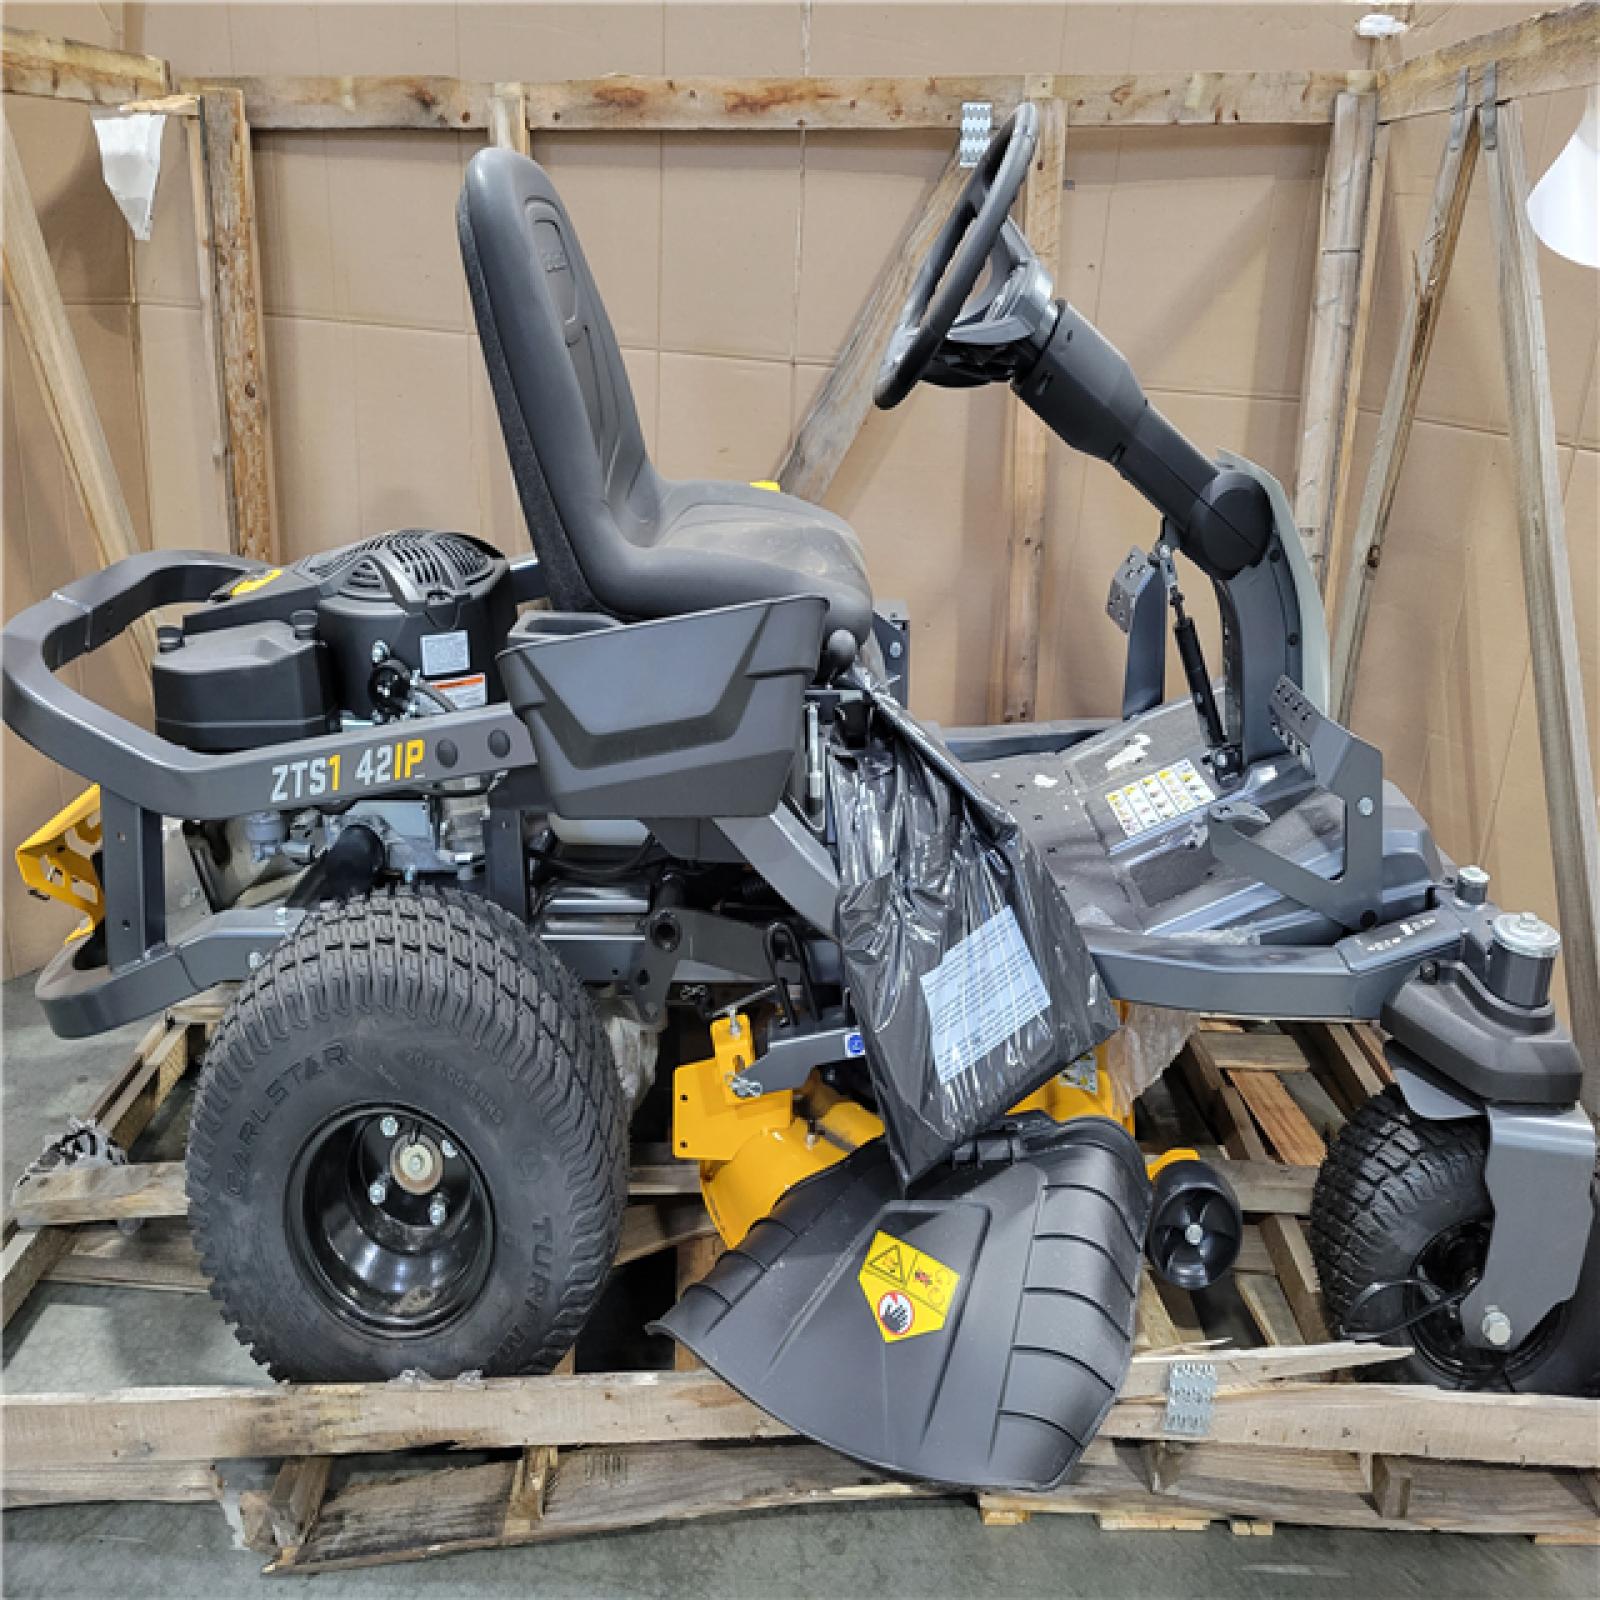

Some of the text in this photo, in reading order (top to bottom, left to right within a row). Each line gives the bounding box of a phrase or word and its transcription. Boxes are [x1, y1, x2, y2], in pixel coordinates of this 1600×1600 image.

[270, 739, 425, 803] ZTS1 42IP
[225, 1040, 350, 1198] CARLSTAR
